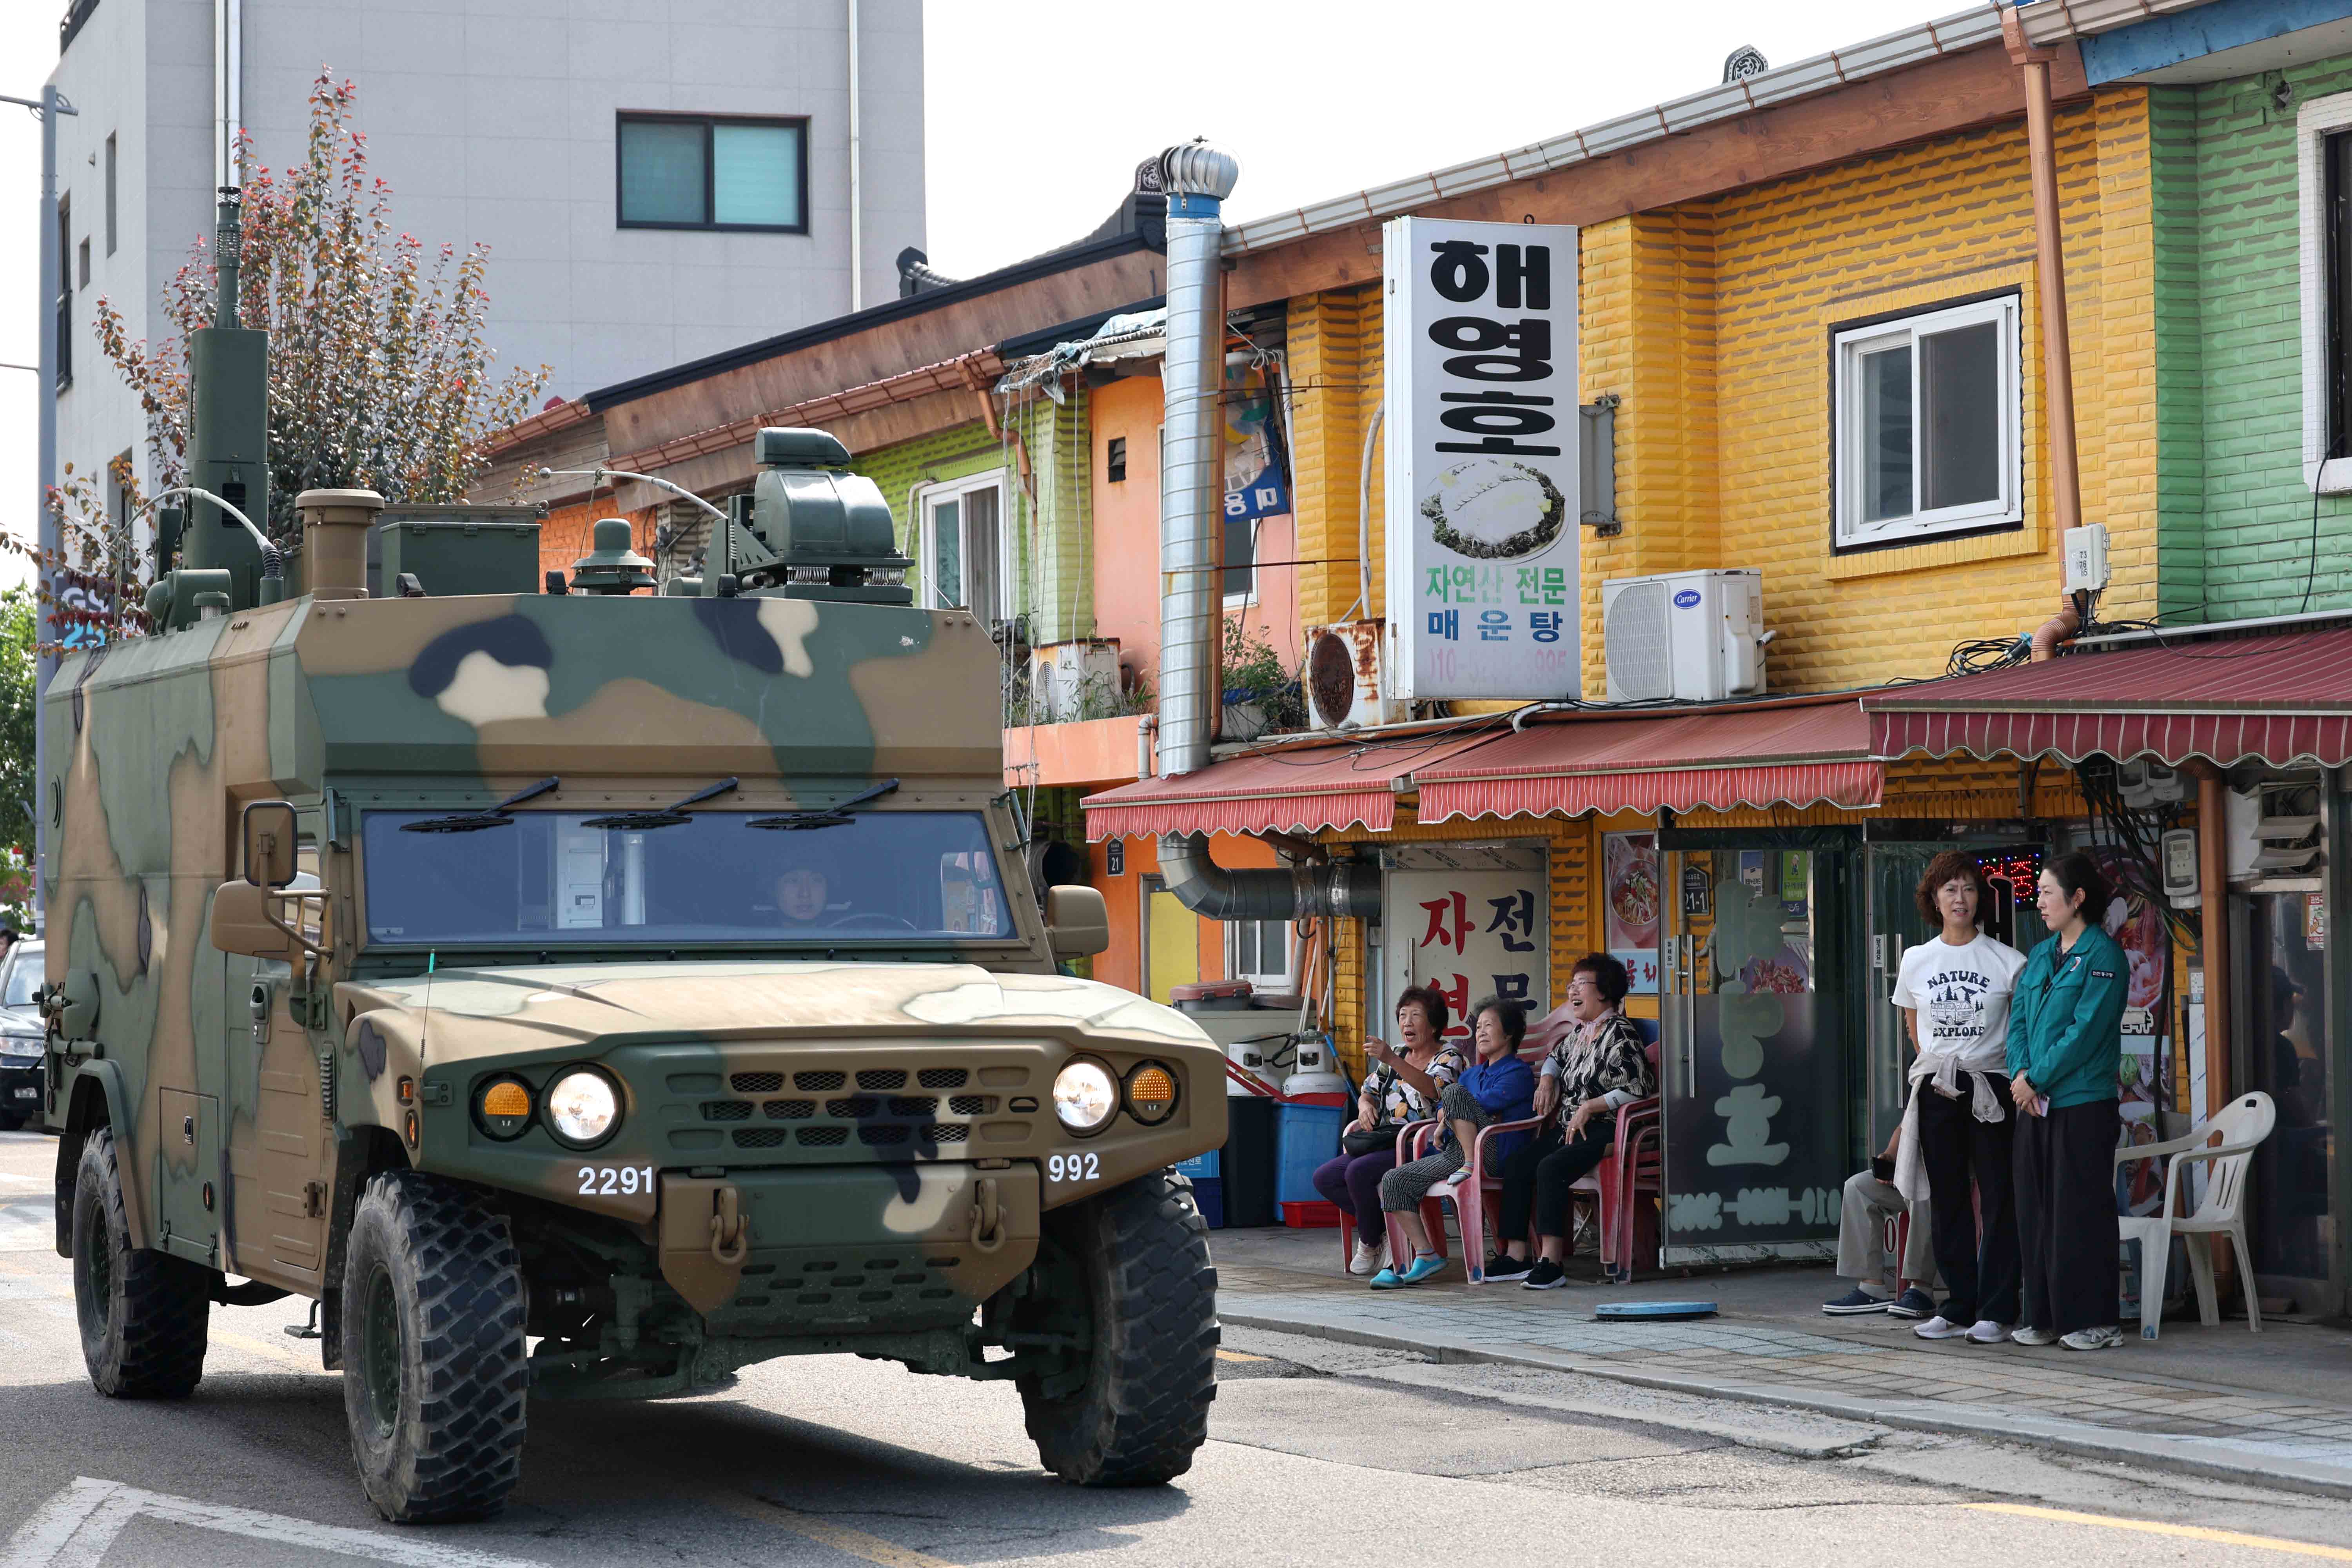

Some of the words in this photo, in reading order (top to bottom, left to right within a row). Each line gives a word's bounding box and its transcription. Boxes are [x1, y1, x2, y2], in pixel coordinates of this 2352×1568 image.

[1428, 240, 1561, 456] 해영호
[1425, 564, 1504, 604] 자연산
[1516, 566, 1567, 605] 전문
[1677, 594, 1698, 604] Carrier
[1112, 857, 1118, 871] 21
[1927, 970, 1990, 990] NATURE
[1933, 1026, 1985, 1037] EXPLORE
[1049, 1152, 1100, 1182] 992
[578, 1166, 652, 1195] 2291
